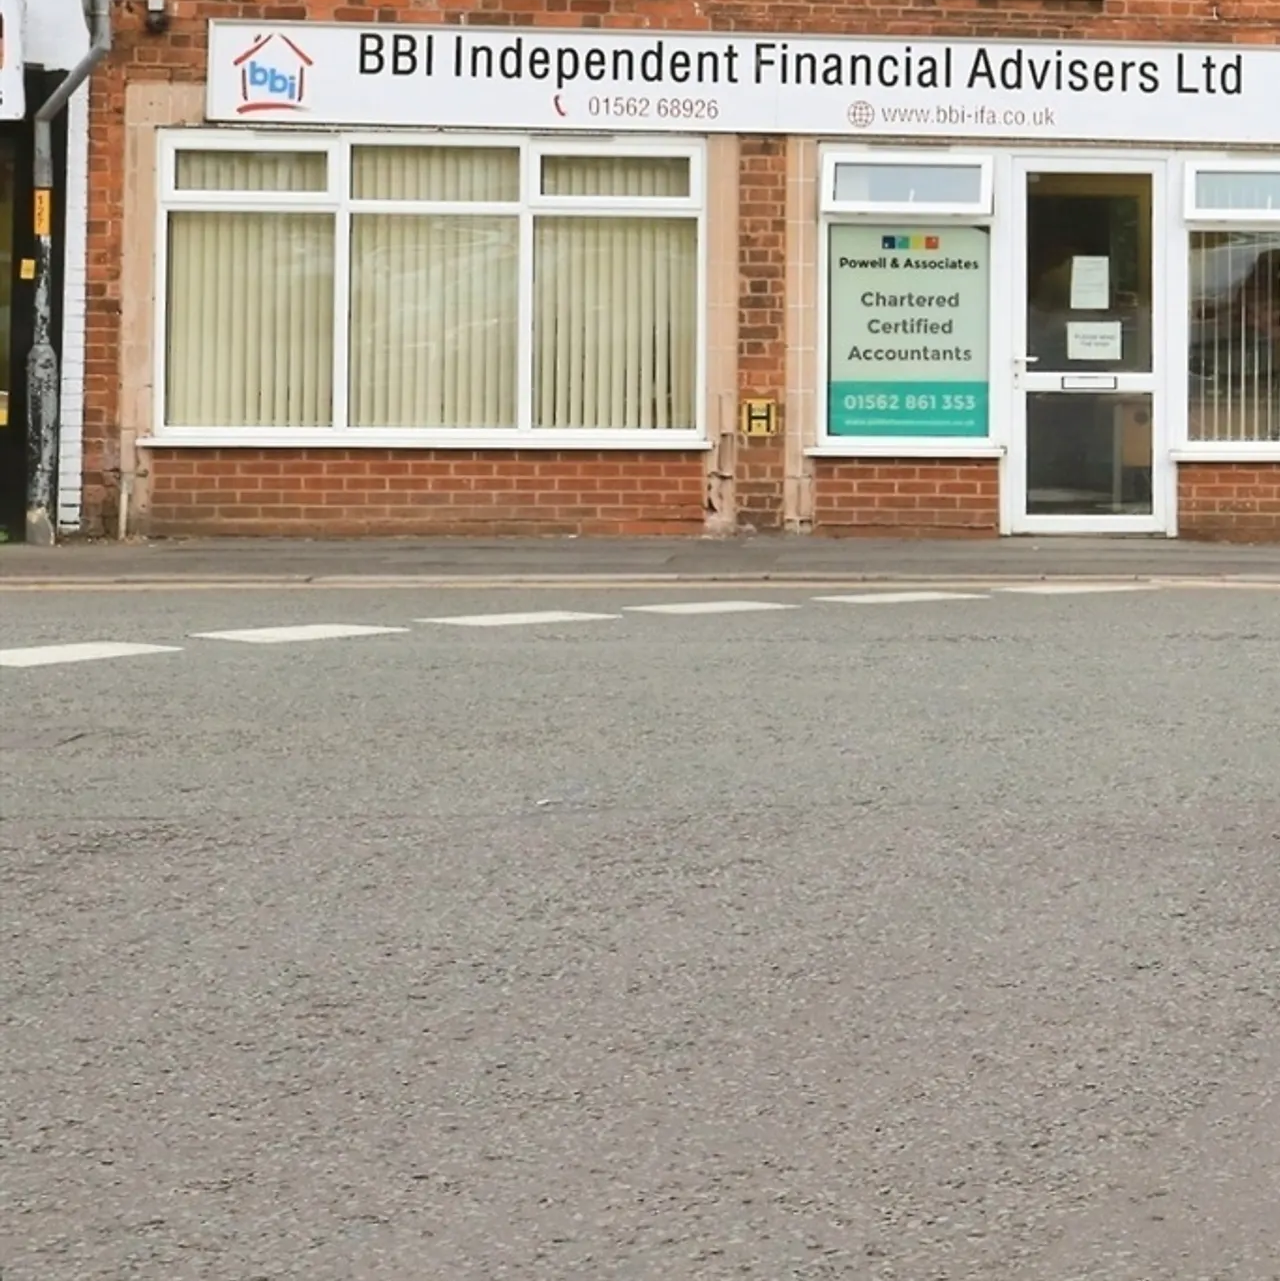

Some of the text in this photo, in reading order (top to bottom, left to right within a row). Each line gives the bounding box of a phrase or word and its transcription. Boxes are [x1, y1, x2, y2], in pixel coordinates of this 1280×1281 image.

[359, 33, 1243, 95] BBI Independent Financial Advisers Ltd
[249, 61, 296, 100] bbi
[588, 96, 719, 119] 01562 68926
[881, 104, 1056, 127] www.bbi-ifa.co.uk
[839, 257, 979, 270] Powell & Associates
[860, 291, 960, 308] Chartered
[867, 318, 953, 335] Certified
[848, 345, 972, 361] Accountants
[844, 394, 976, 410] 01562 861 353
